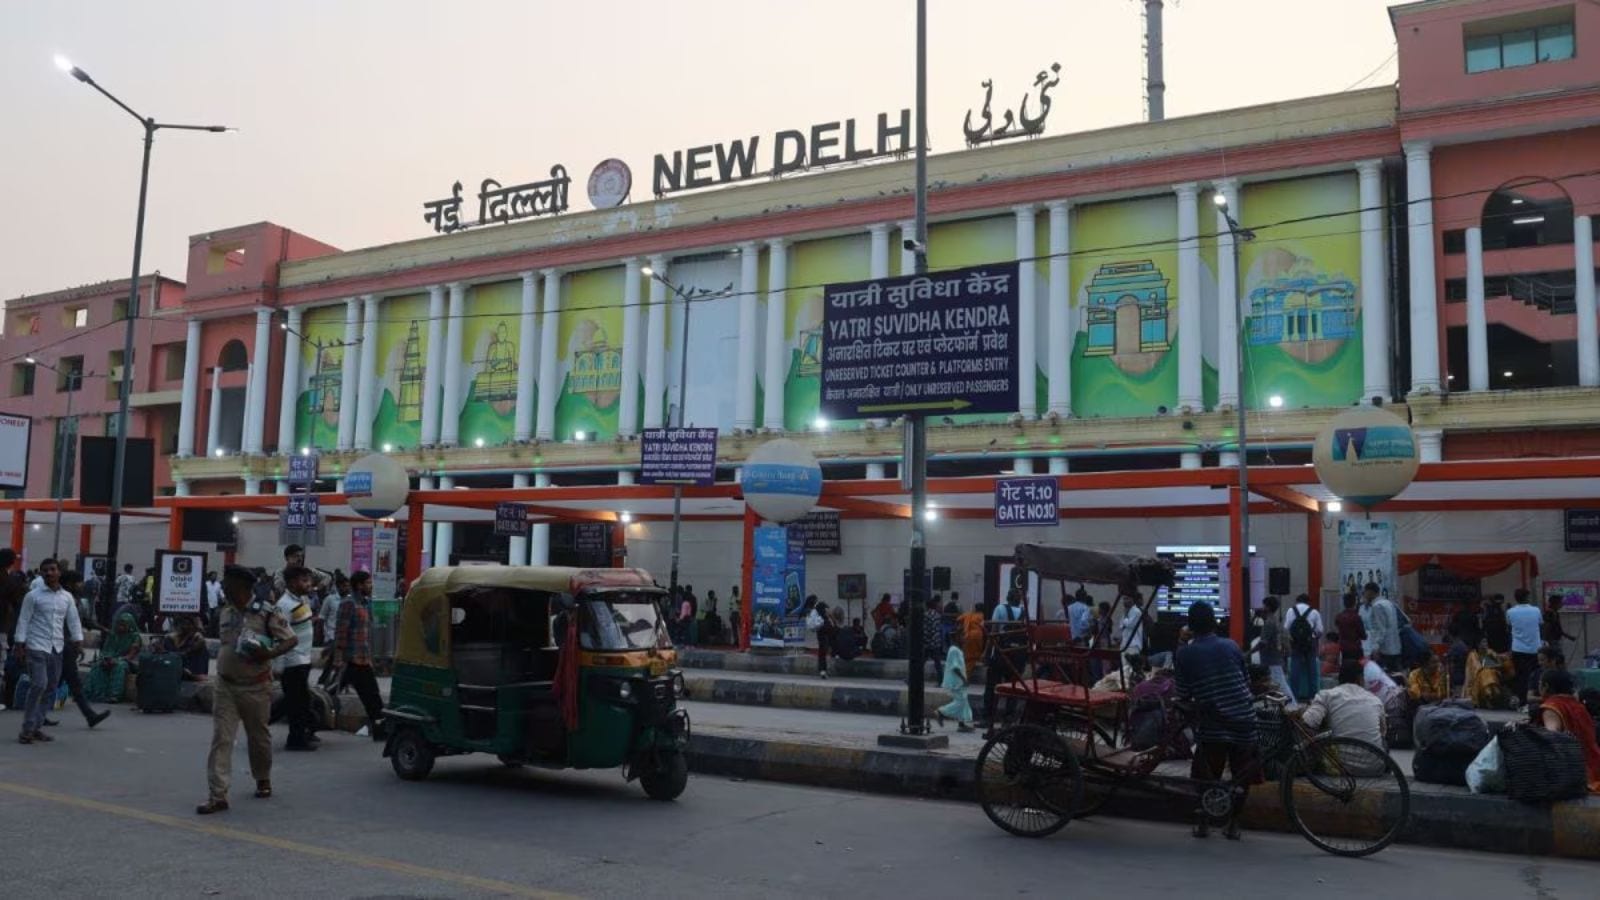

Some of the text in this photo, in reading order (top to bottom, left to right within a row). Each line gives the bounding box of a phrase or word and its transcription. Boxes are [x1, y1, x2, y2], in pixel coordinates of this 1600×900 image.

[653, 135, 760, 192] NEW
[773, 108, 911, 174] DELH
[424, 180, 463, 233] नई
[478, 163, 571, 224] दिल्ली
[830, 272, 1010, 308] यात्री सुविधा केंद्र
[830, 304, 1010, 340] YATRI SUVIDHA KENDRA
[828, 340, 871, 361] अनारक्षित
[873, 338, 900, 358] टिकट
[917, 333, 931, 354] एवं
[982, 329, 1008, 350] प्रवेश
[825, 357, 1008, 381] UNRESERVED TICKET COUNTER & PLATFORMS ENTRY
[923, 381, 965, 395] UNRESERVED
[966, 379, 1009, 393] PASSENGERS
[1001, 482, 1053, 500] गेट नं.10
[999, 504, 1025, 520] GATE
